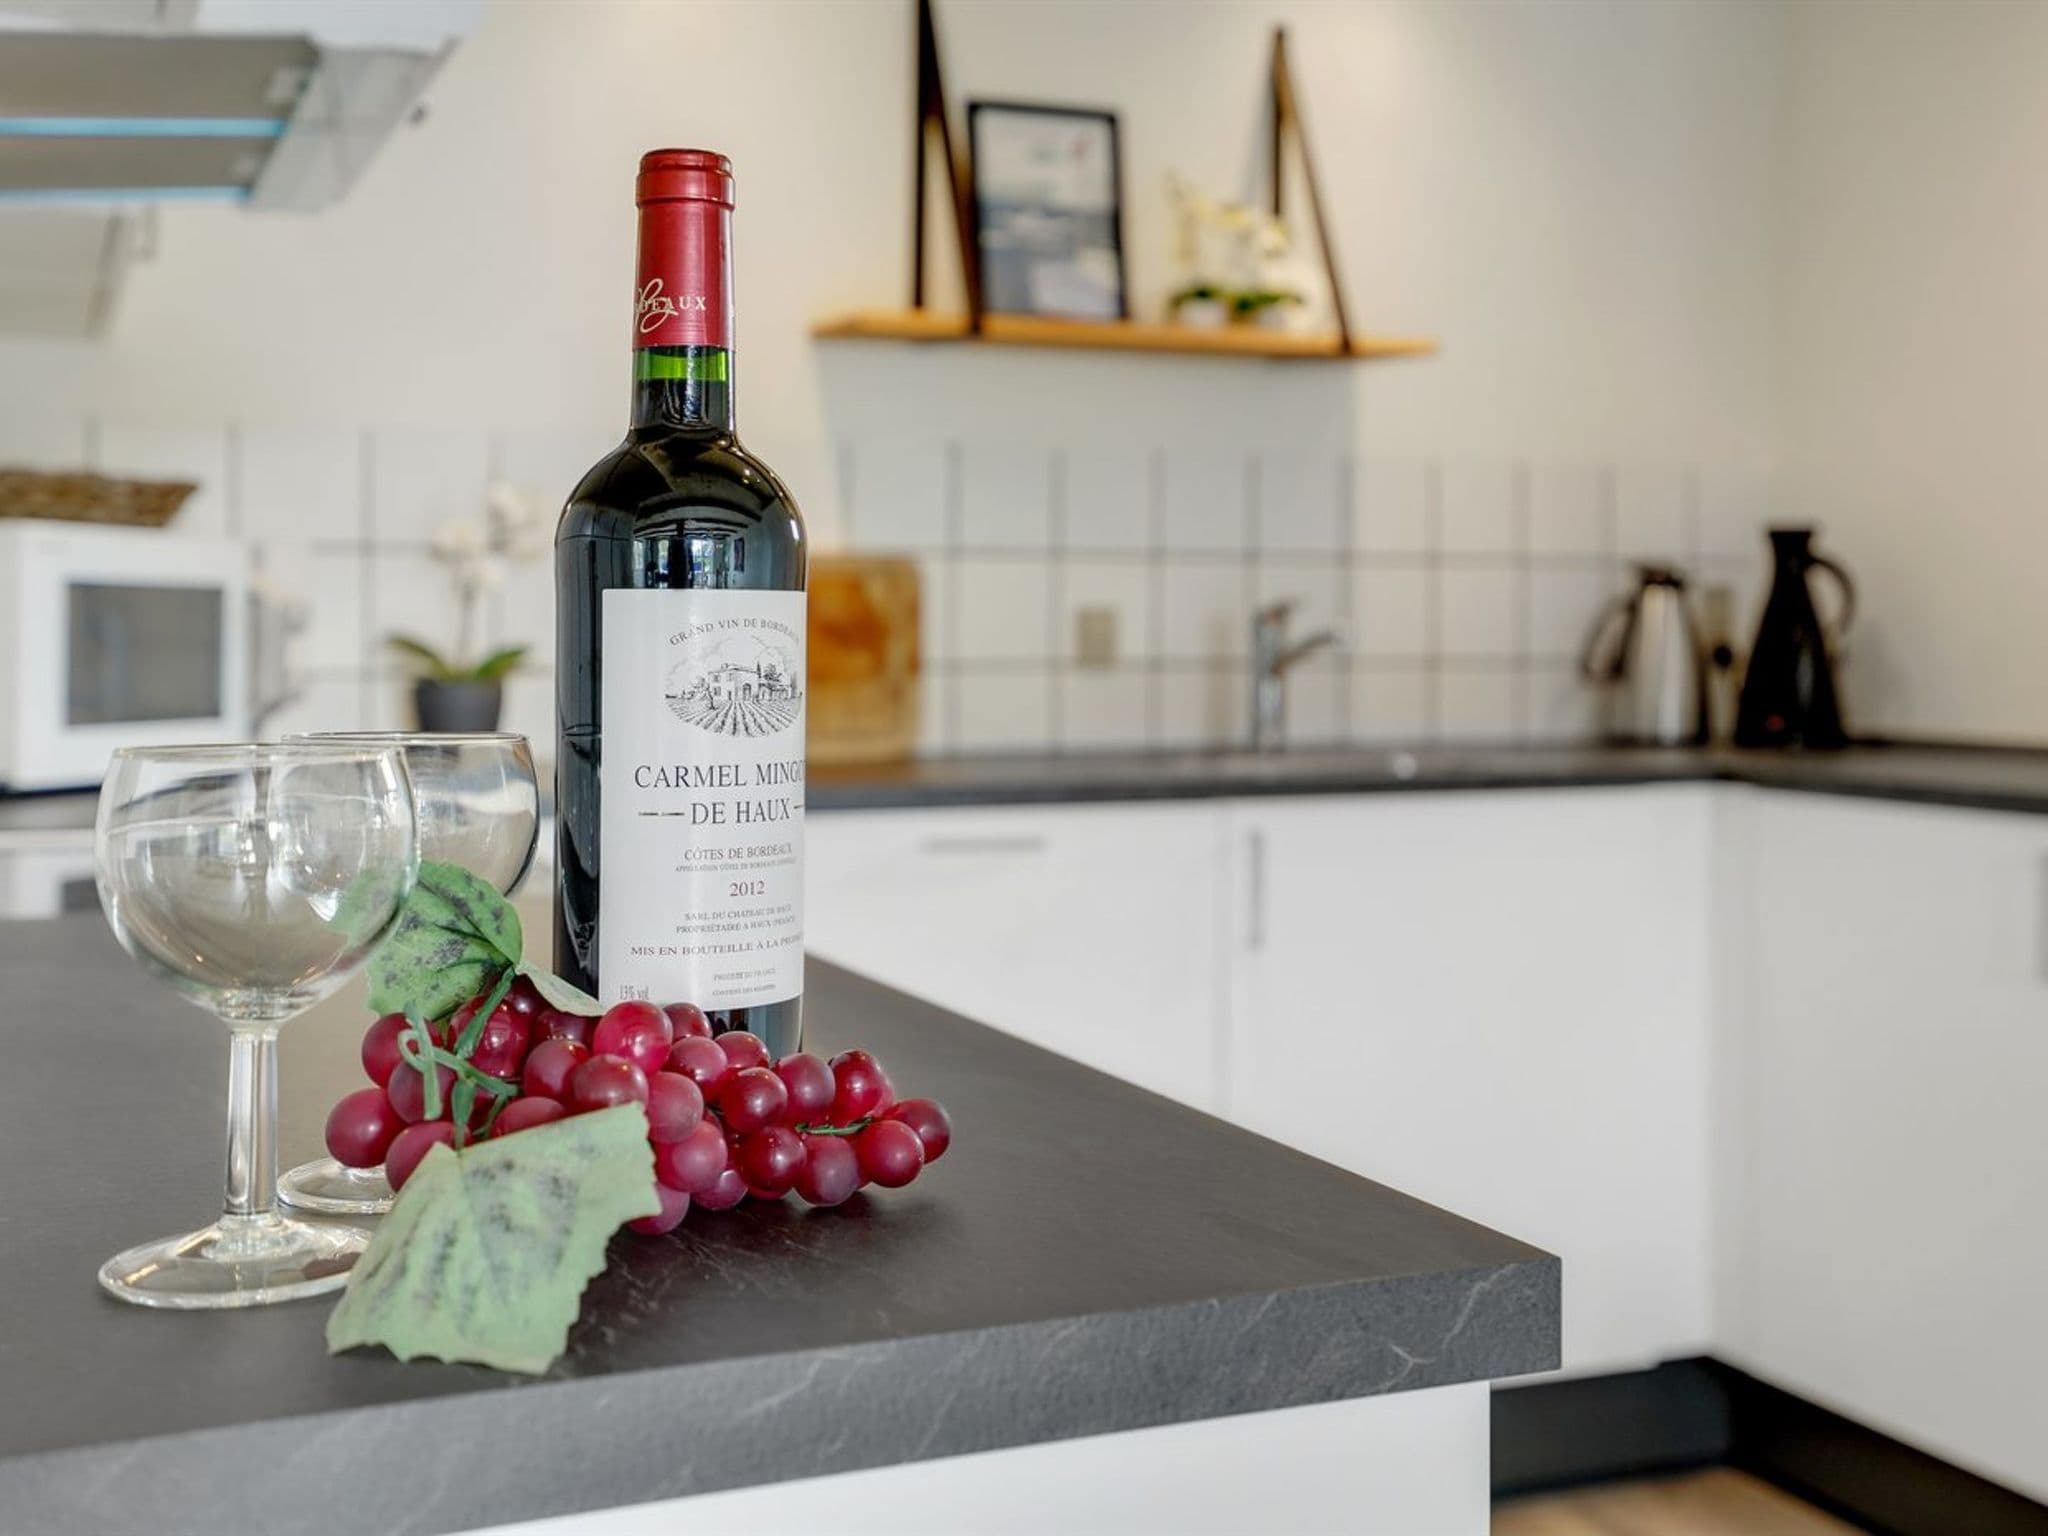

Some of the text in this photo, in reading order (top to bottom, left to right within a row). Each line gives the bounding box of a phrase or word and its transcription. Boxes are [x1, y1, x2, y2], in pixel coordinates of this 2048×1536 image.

[669, 623, 714, 645] GRAND
[718, 619, 738, 629] VIN
[744, 618, 757, 628] DE
[634, 764, 747, 788] CARMEL
[691, 798, 790, 825] DE HAUX
[684, 842, 792, 861] CÔTES DE BORDEAUX
[729, 880, 765, 897] 2012
[712, 910, 726, 920] DU
[631, 946, 655, 956] MIS
[659, 946, 677, 956] EN
[682, 942, 753, 956] BOUTEILLE
[766, 938, 779, 948] LA
